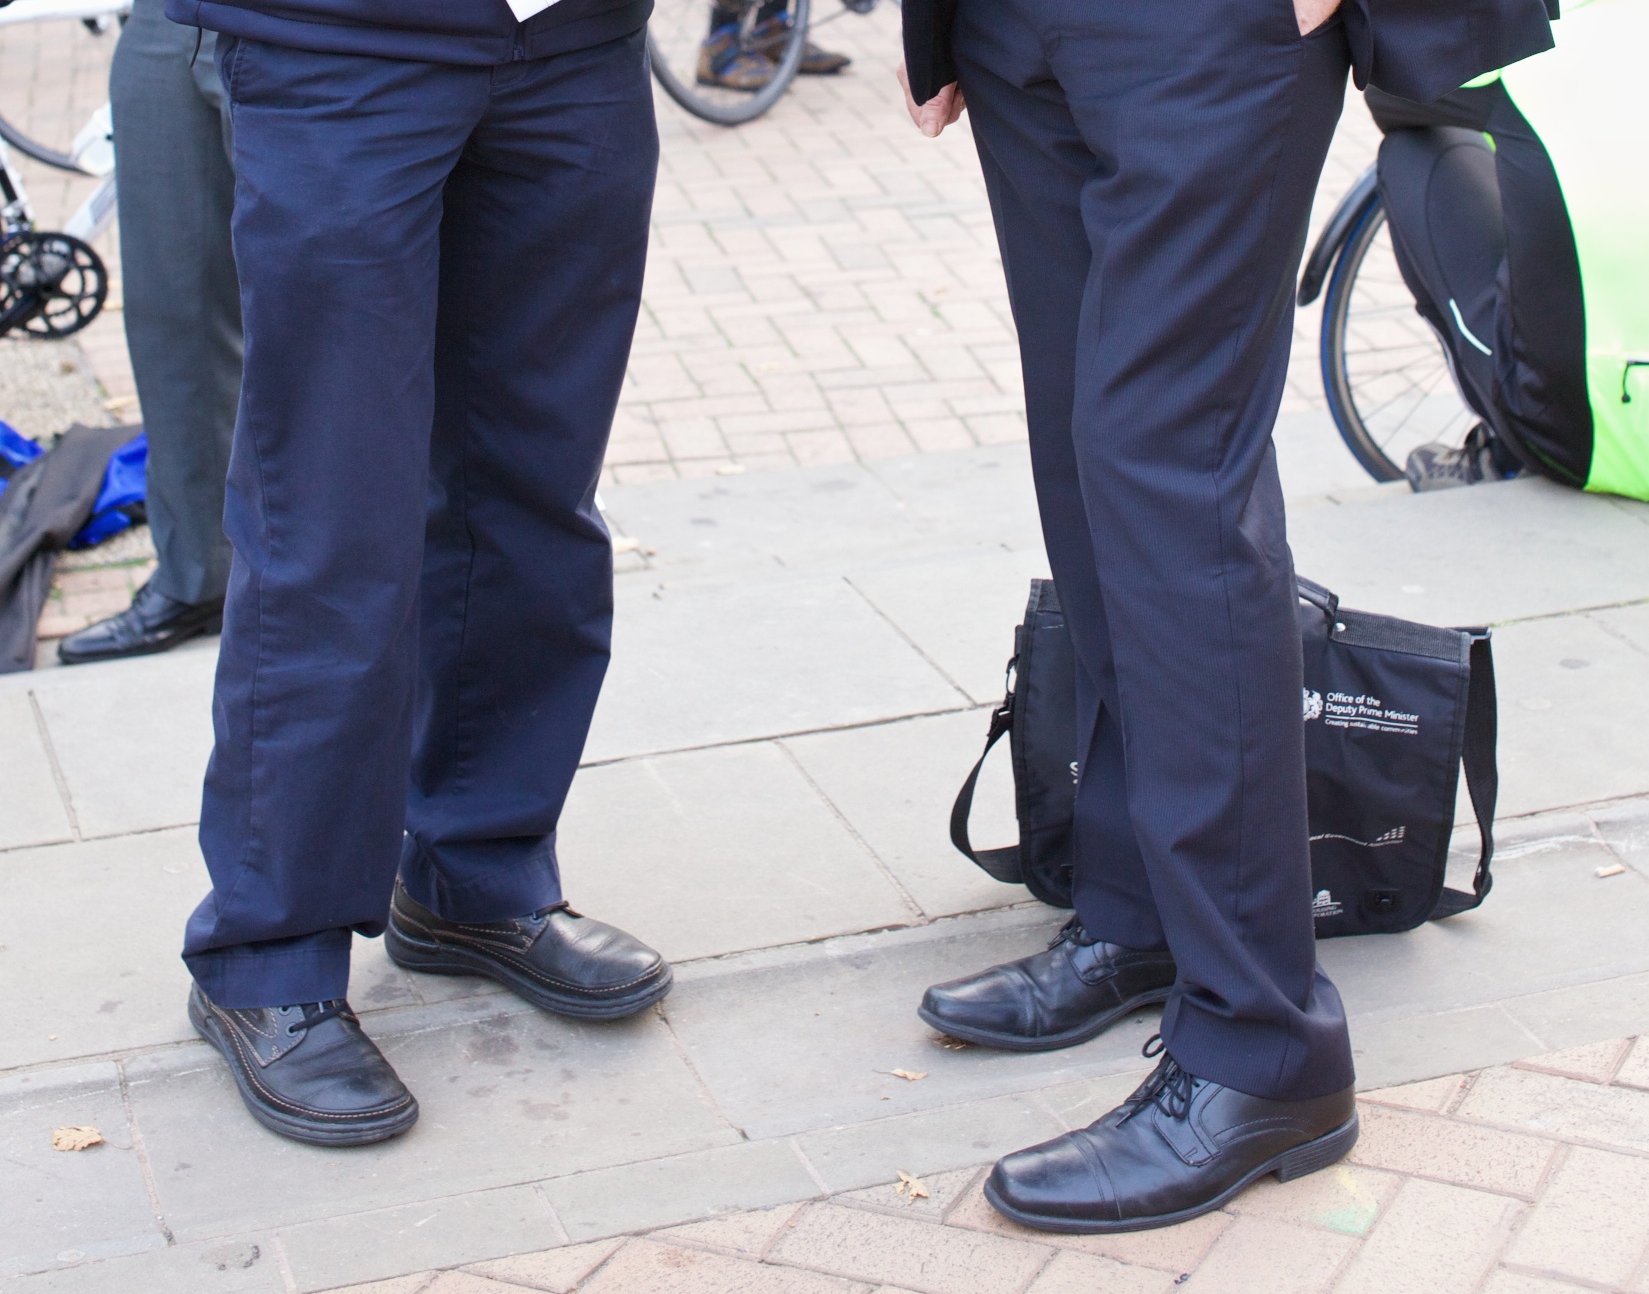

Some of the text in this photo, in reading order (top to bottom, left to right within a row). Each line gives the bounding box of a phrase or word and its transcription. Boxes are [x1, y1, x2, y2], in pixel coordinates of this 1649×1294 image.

[1327, 692, 1381, 707] Office of the
[1325, 703, 1419, 722] Deputy Prime Minister
[1325, 718, 1348, 728] Creating
